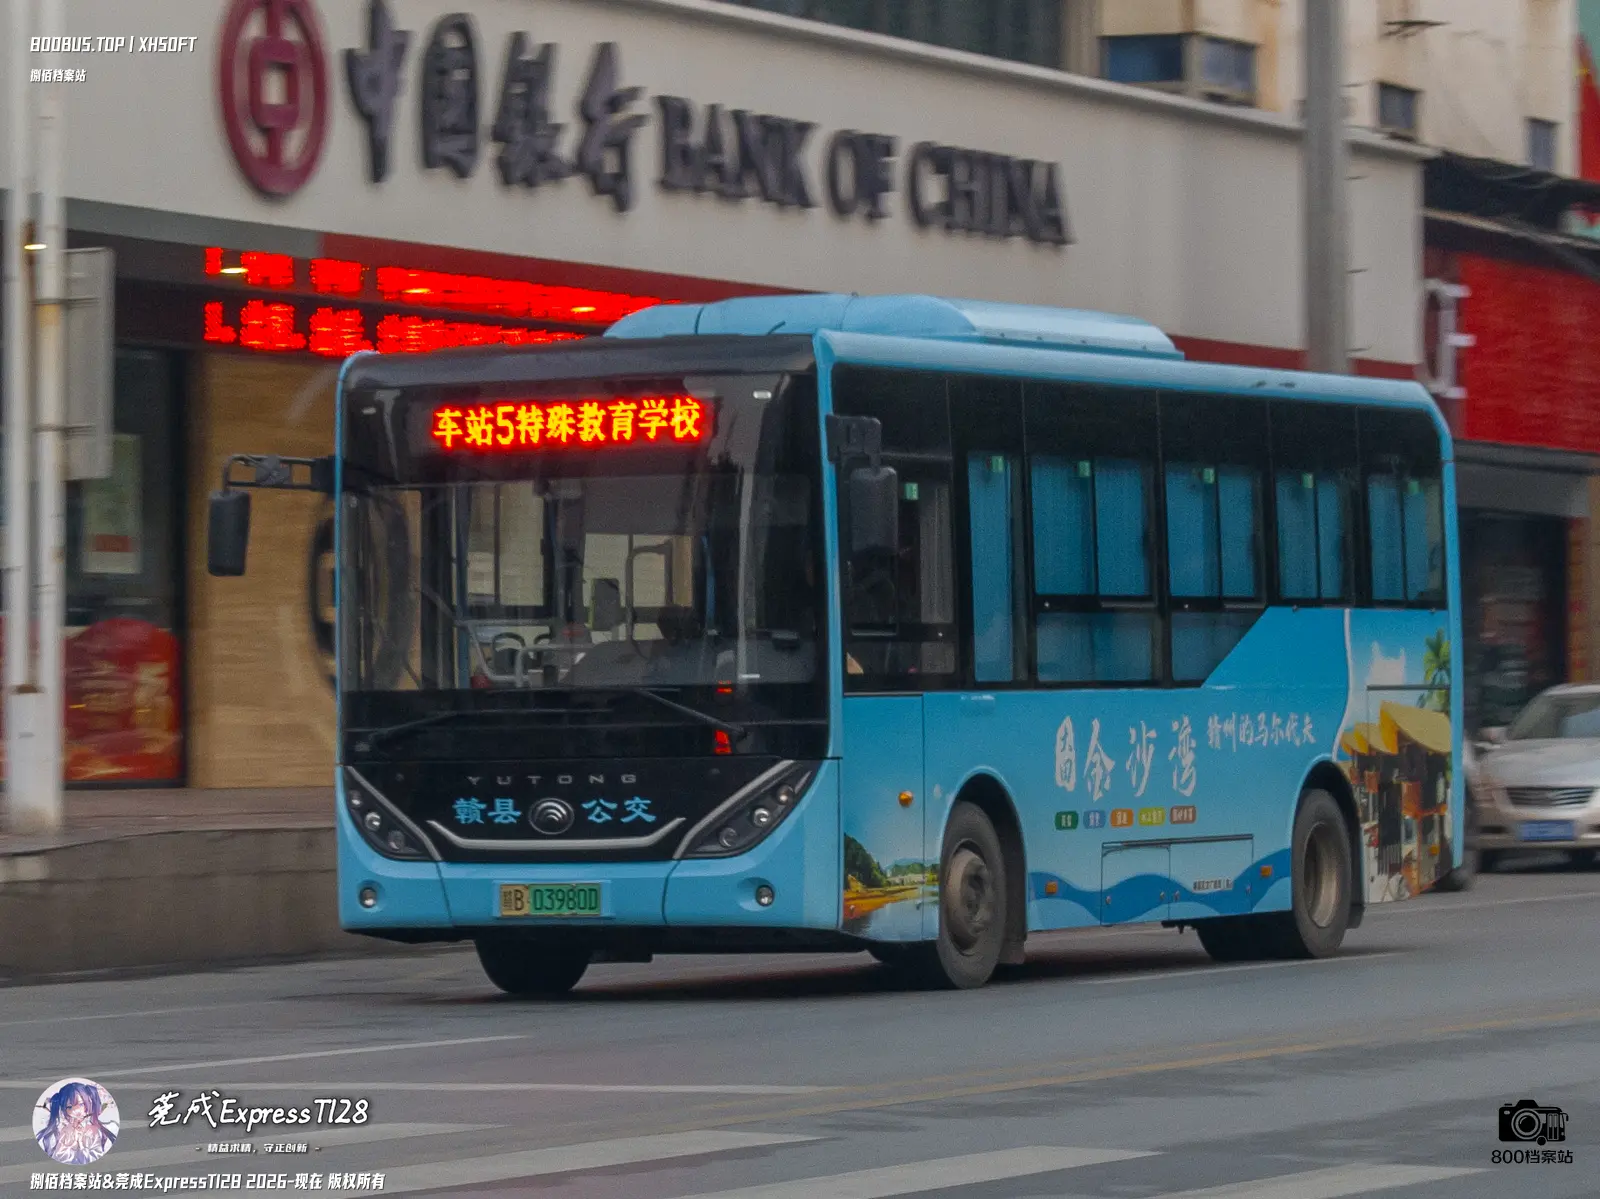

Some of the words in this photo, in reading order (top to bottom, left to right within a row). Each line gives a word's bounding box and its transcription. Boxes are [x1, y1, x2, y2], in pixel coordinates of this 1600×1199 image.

[341, 0, 649, 213] 中国银行
[652, 95, 818, 209] BANK
[827, 130, 899, 219] OF
[908, 142, 1074, 246] CHINA
[433, 397, 701, 447] 车站5特殊教育学校
[468, 774, 638, 786] YUTONG
[452, 797, 522, 825] 赣县
[581, 796, 657, 824] 公交
